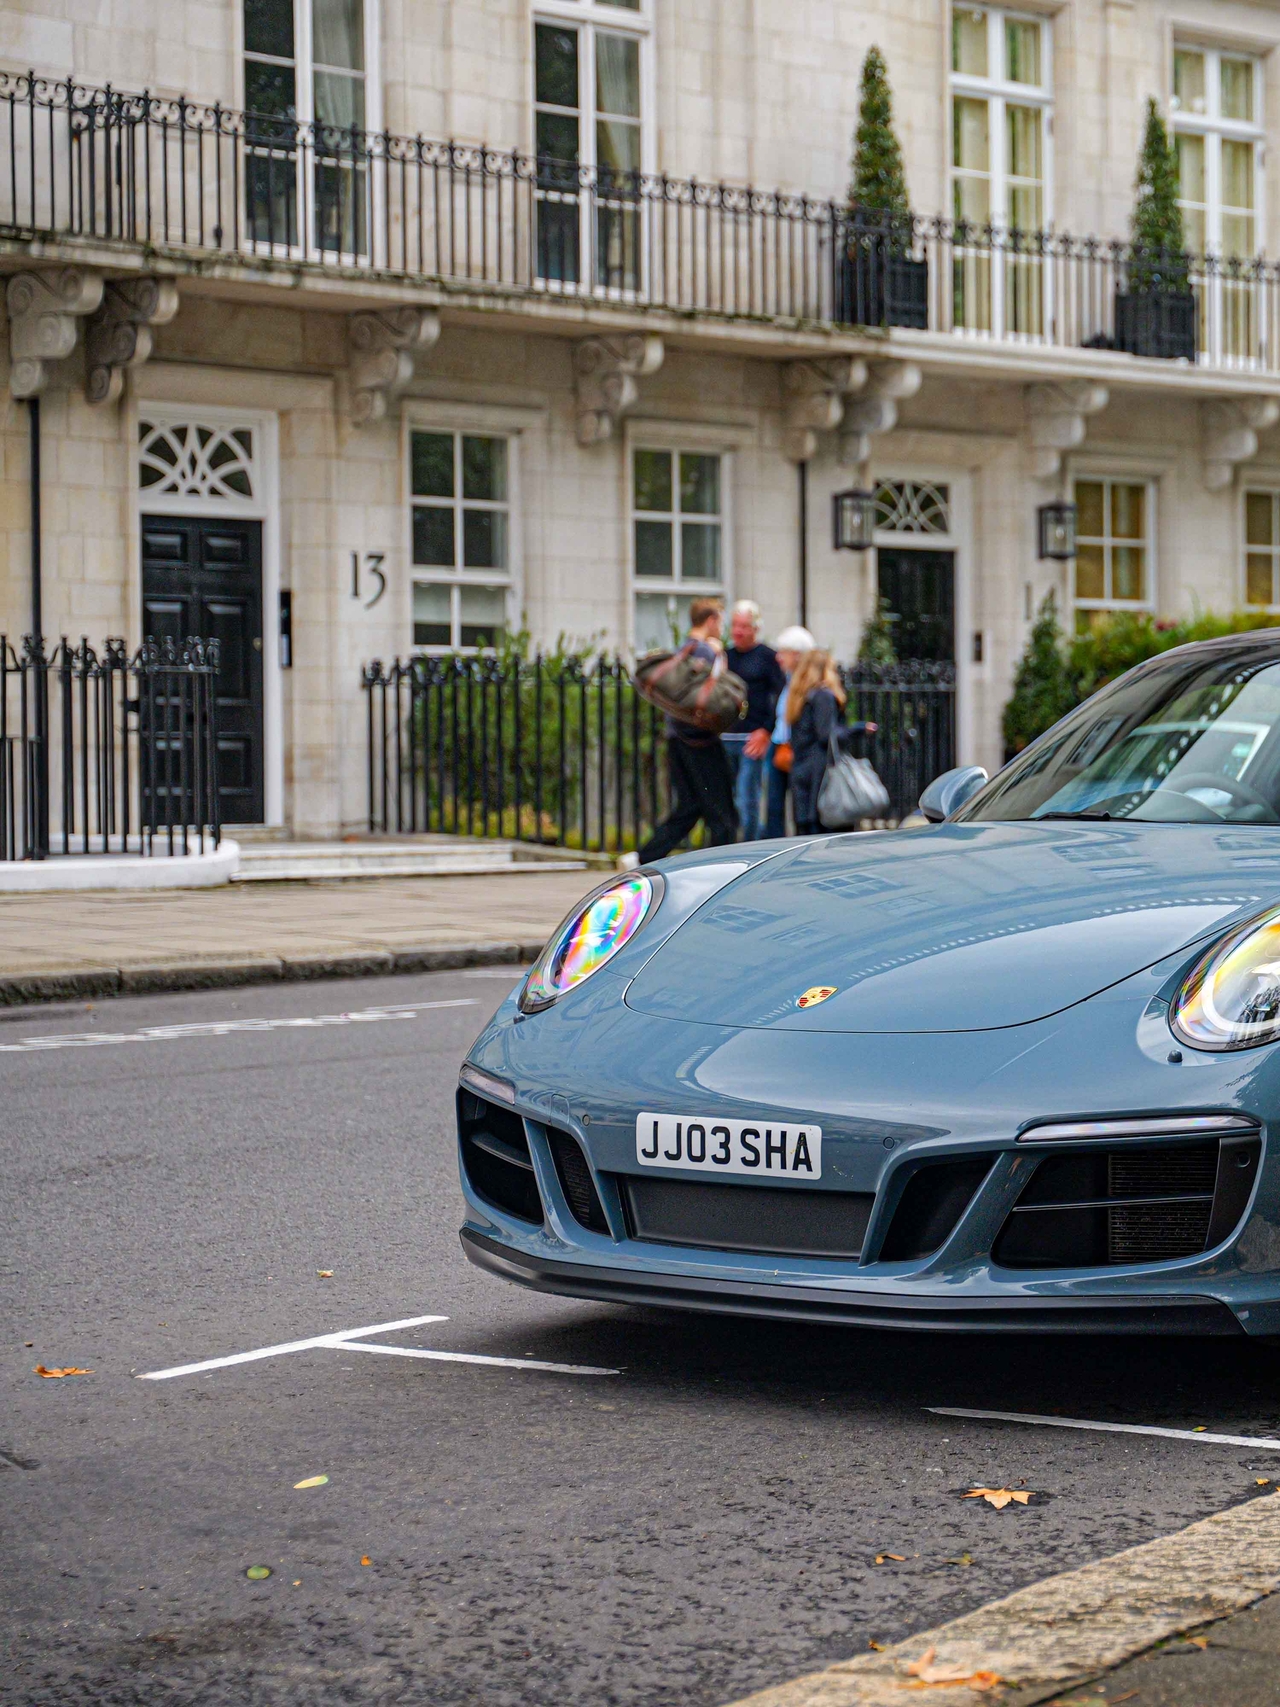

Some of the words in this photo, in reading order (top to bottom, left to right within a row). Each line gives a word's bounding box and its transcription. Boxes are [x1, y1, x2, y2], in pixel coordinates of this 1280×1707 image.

[350, 550, 386, 611] 13
[641, 1120, 731, 1165] JJ03
[740, 1128, 814, 1173] SHA
